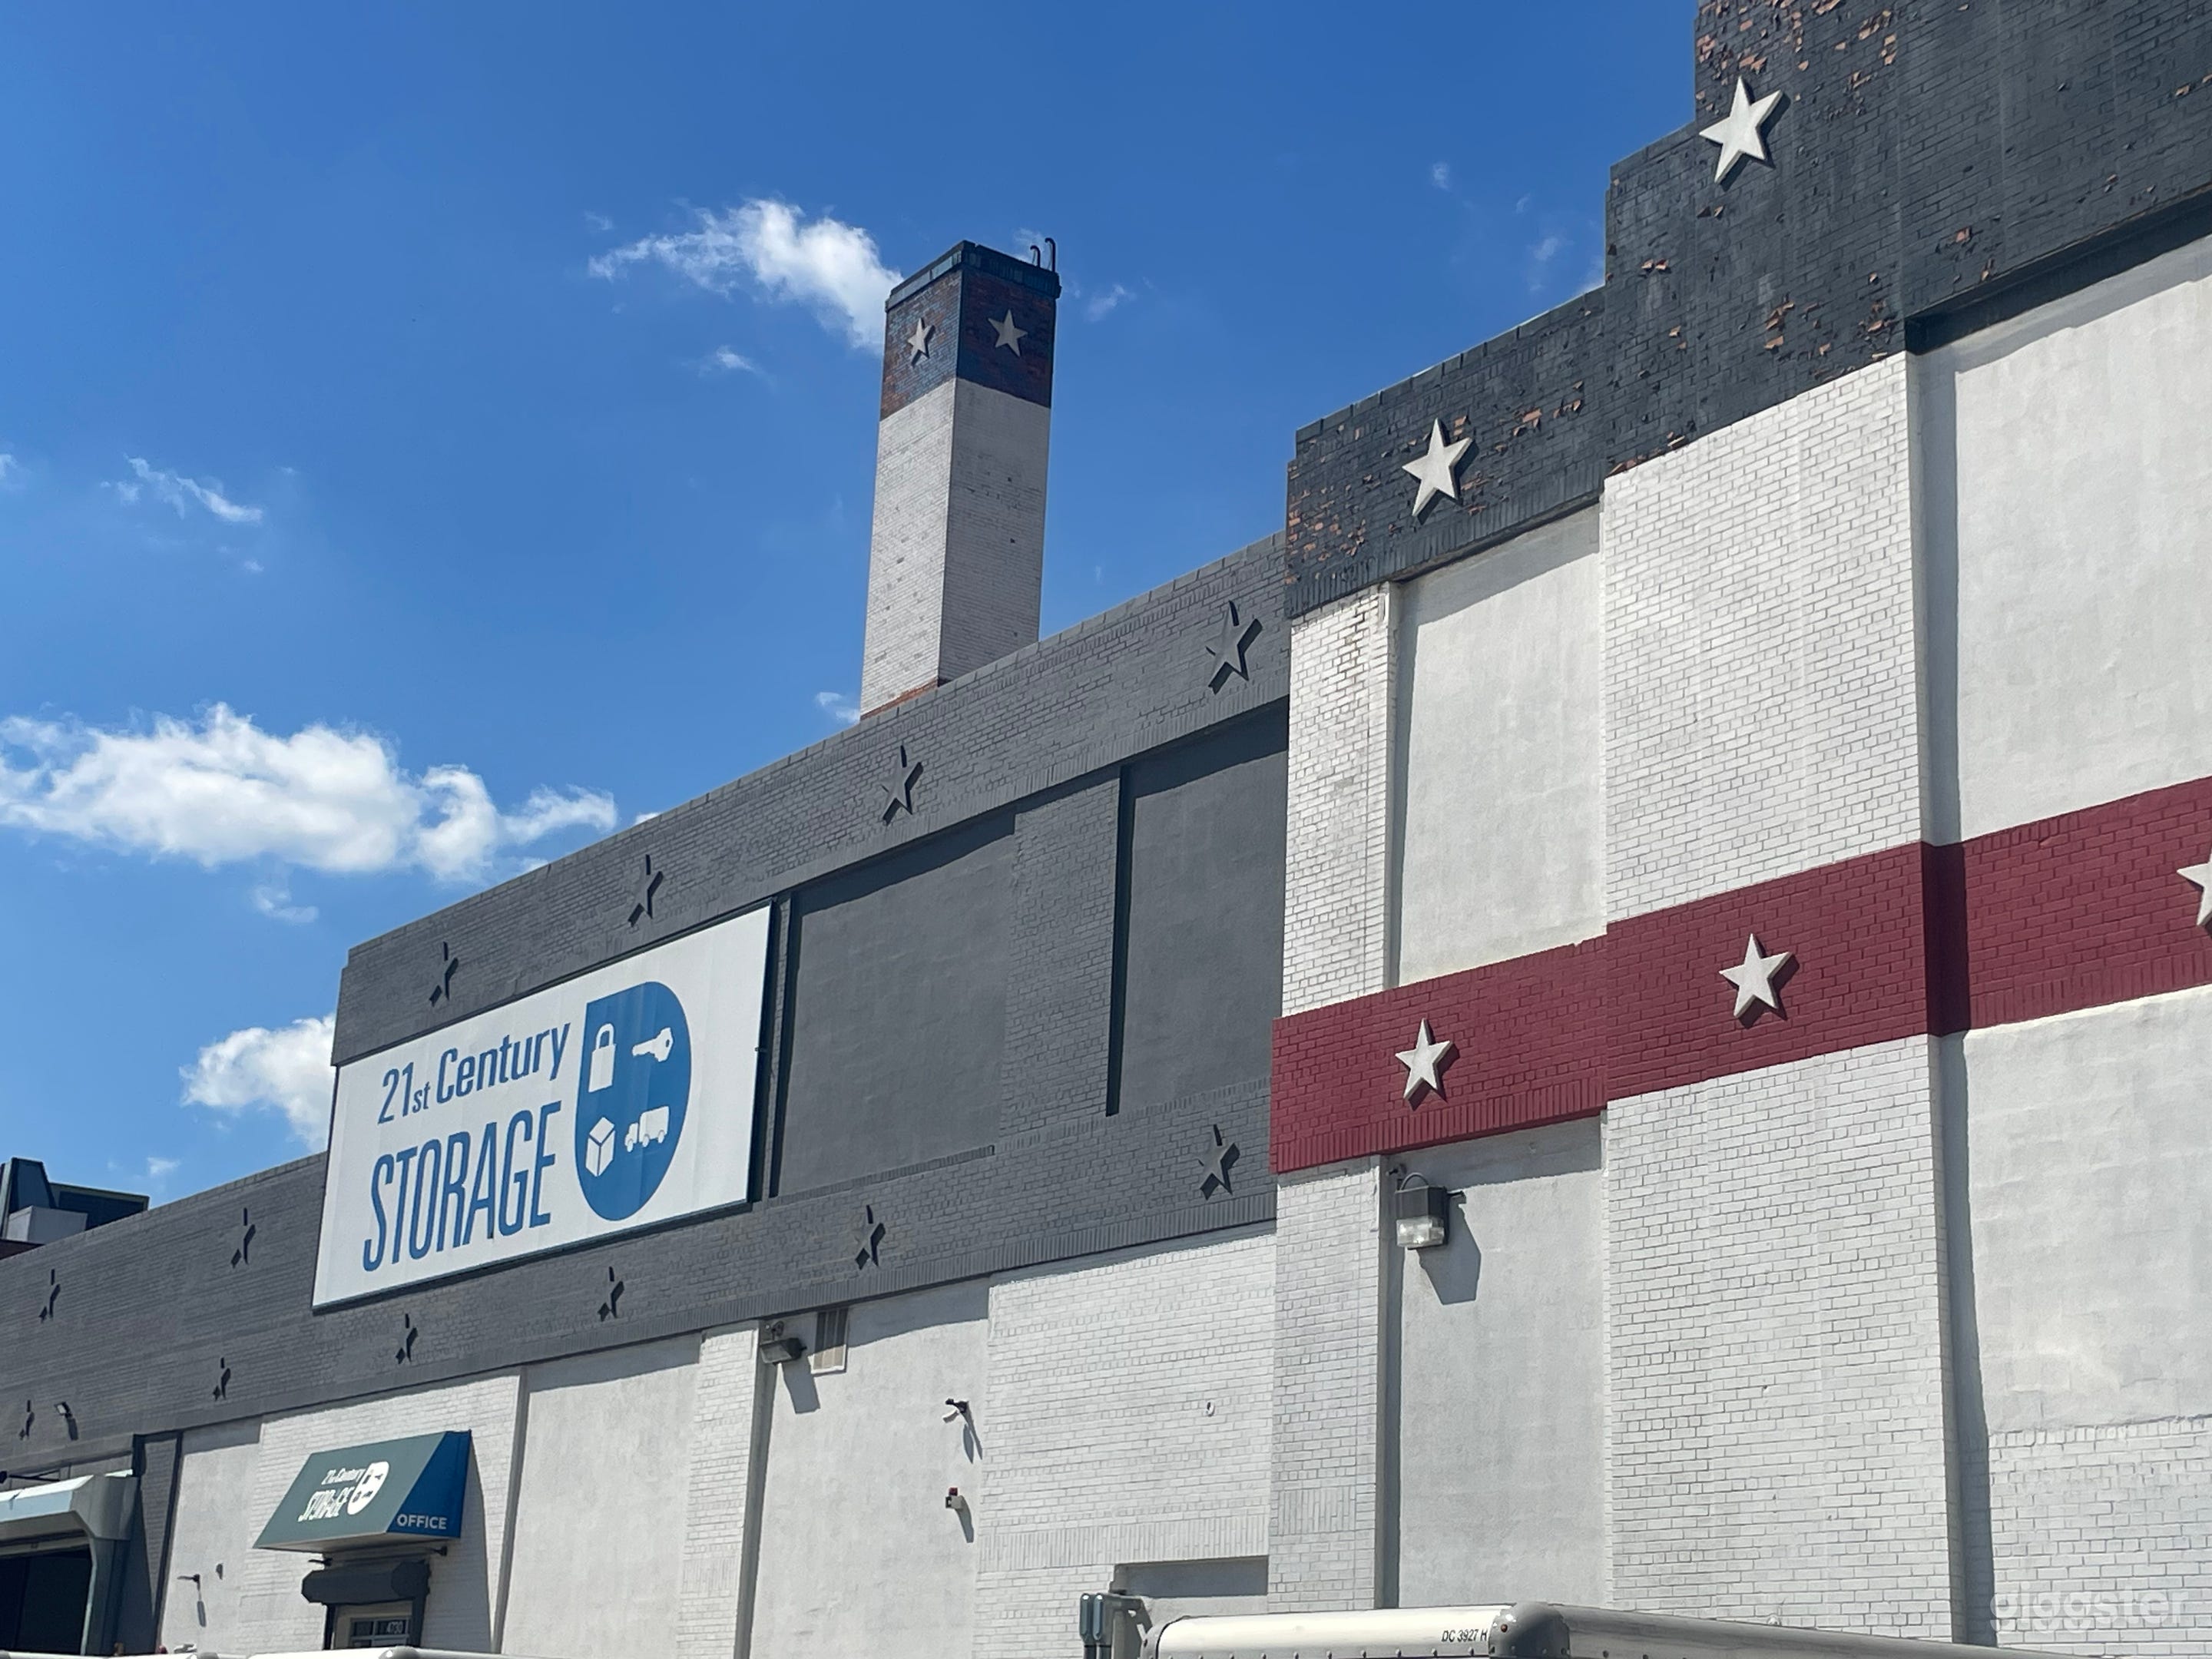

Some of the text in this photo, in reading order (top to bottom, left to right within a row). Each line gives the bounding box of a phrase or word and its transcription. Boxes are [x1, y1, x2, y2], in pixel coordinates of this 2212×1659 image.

[377, 1022, 571, 1124] 21st Century
[363, 1100, 562, 1272] STORAGE
[396, 1513, 447, 1530] OFFICE
[1442, 1628, 1488, 1642] DC 3927 H
